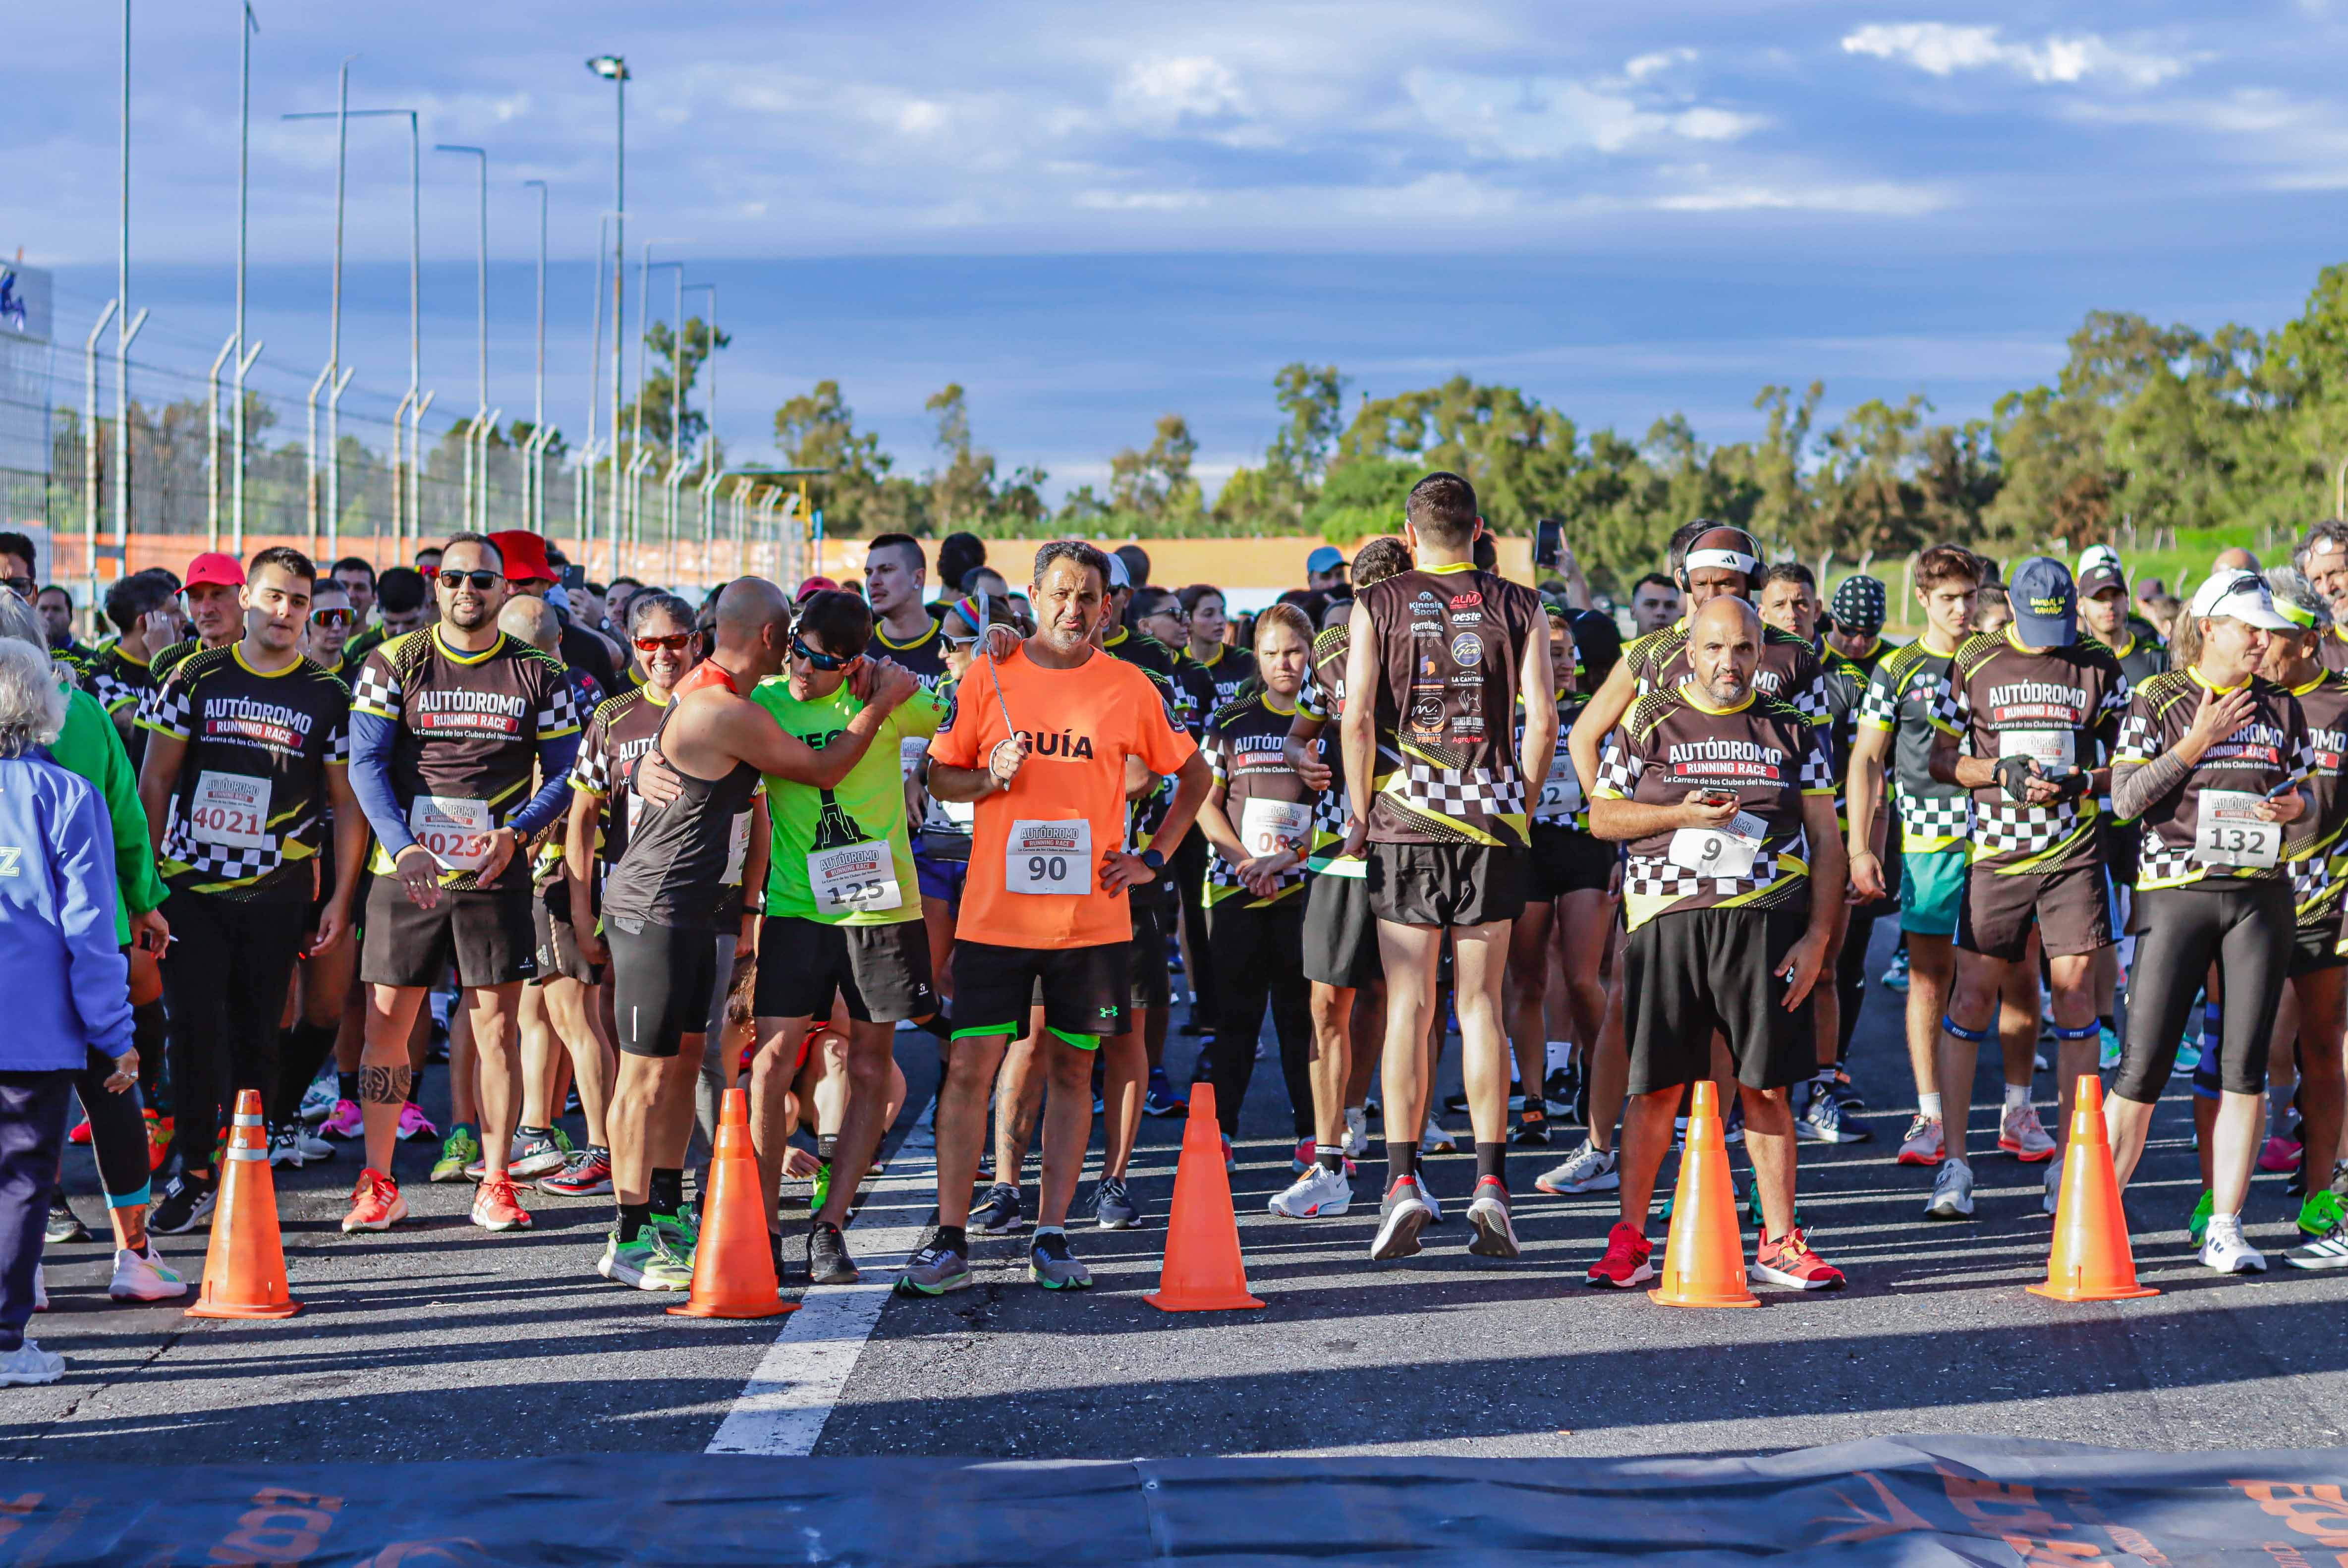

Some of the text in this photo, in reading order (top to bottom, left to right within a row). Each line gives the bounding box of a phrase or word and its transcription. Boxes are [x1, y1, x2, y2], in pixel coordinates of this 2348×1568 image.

[1451, 594, 1477, 604] ALM
[1453, 613, 1481, 622] oeste
[1989, 678, 2086, 709] AUTÓDROMO
[417, 687, 526, 718] AUTÓDROMO
[204, 696, 312, 734] AUTÓDROMO
[2004, 706, 2071, 719] RUNNING RACE
[433, 714, 507, 730] RUNNING RACE
[217, 721, 292, 743] RUNNING RACE
[421, 728, 444, 737] Carrera
[497, 733, 522, 741] Noroeste
[237, 737, 246, 746] los
[247, 740, 268, 750] Clubes
[1010, 728, 1093, 760] GUÍA
[1669, 736, 1782, 766] AUTÓDROMO
[2246, 745, 2270, 759] RACE
[1245, 752, 1284, 764] RUNNING
[2232, 761, 2253, 769] Clubes
[1687, 763, 1767, 776] RUNNING RACE
[206, 778, 259, 796] AUTÓDROMO
[1759, 780, 1789, 788] Noroeste
[422, 802, 478, 817] AUTÓDROMO
[193, 806, 259, 836] 4021
[1020, 825, 1079, 840] AUTÓDROMO
[2210, 828, 2265, 854] 132
[1701, 838, 1722, 861] 9
[820, 850, 879, 871] AUTÓDROMO
[1029, 856, 1066, 881] 90
[831, 865, 855, 876] RUNNING
[827, 878, 885, 905] 125
[524, 1139, 552, 1157] FILA
